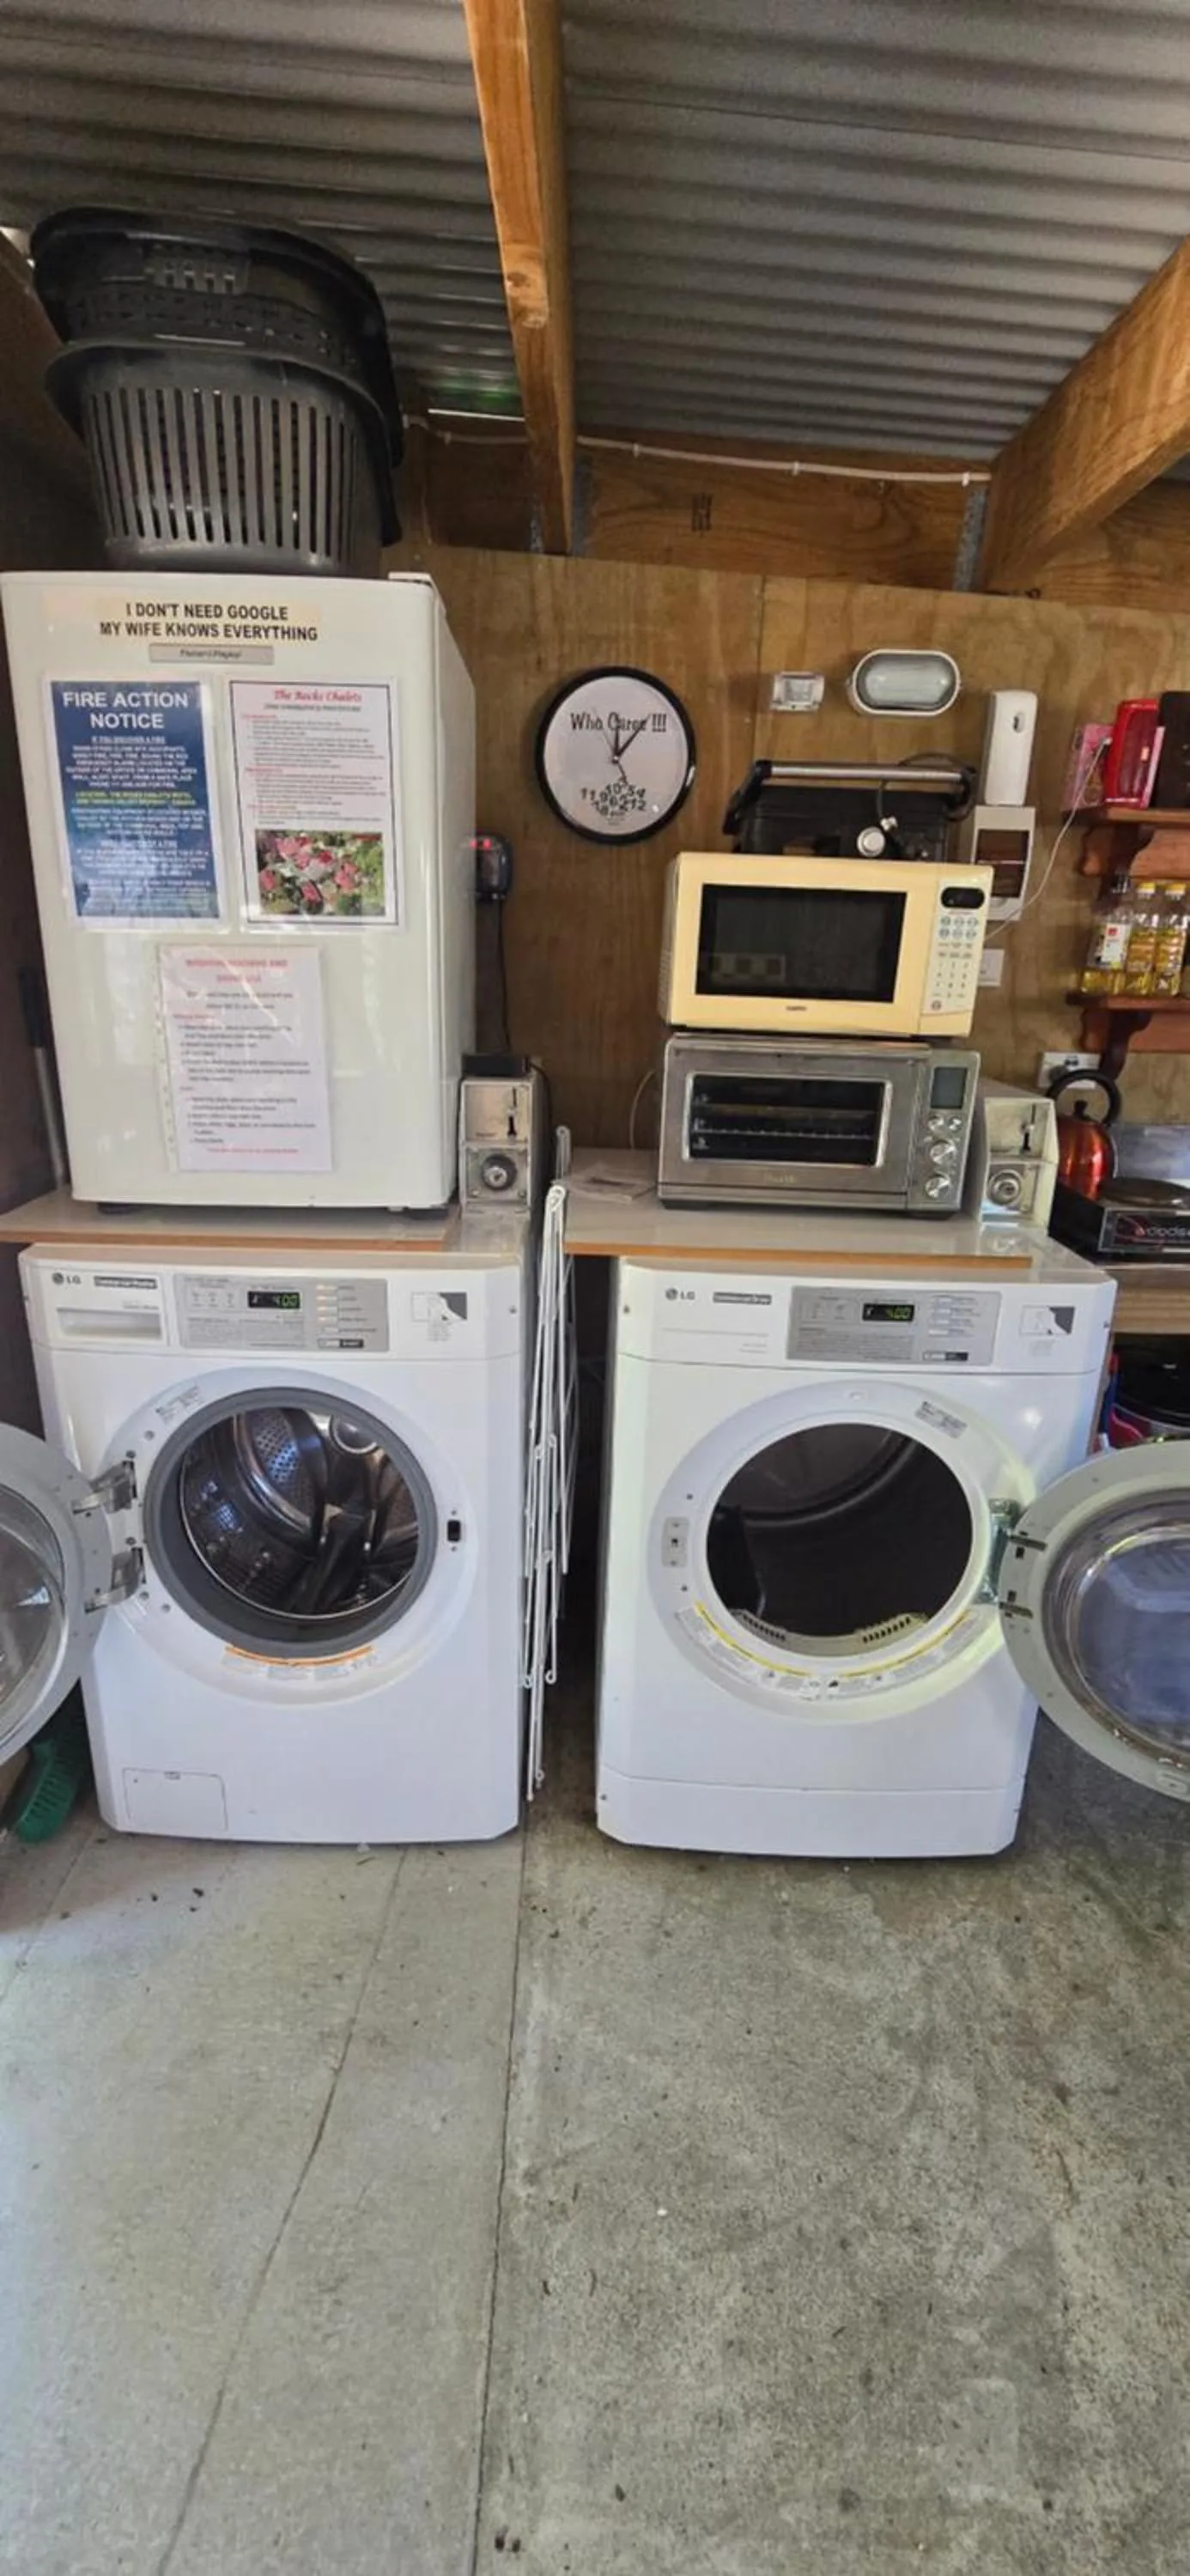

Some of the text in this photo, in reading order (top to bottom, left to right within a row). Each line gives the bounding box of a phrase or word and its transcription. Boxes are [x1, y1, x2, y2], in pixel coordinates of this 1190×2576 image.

[126, 603, 288, 621] I DON'T NEED GOOGLE
[100, 622, 319, 641] MY WIFE KNOWS EVERYTHING
[63, 691, 189, 708] FIRE ACTION
[90, 713, 165, 729] NOTICE
[570, 712, 603, 731] Who
[66, 1276, 82, 1285] LG
[680, 1291, 695, 1301] LG
